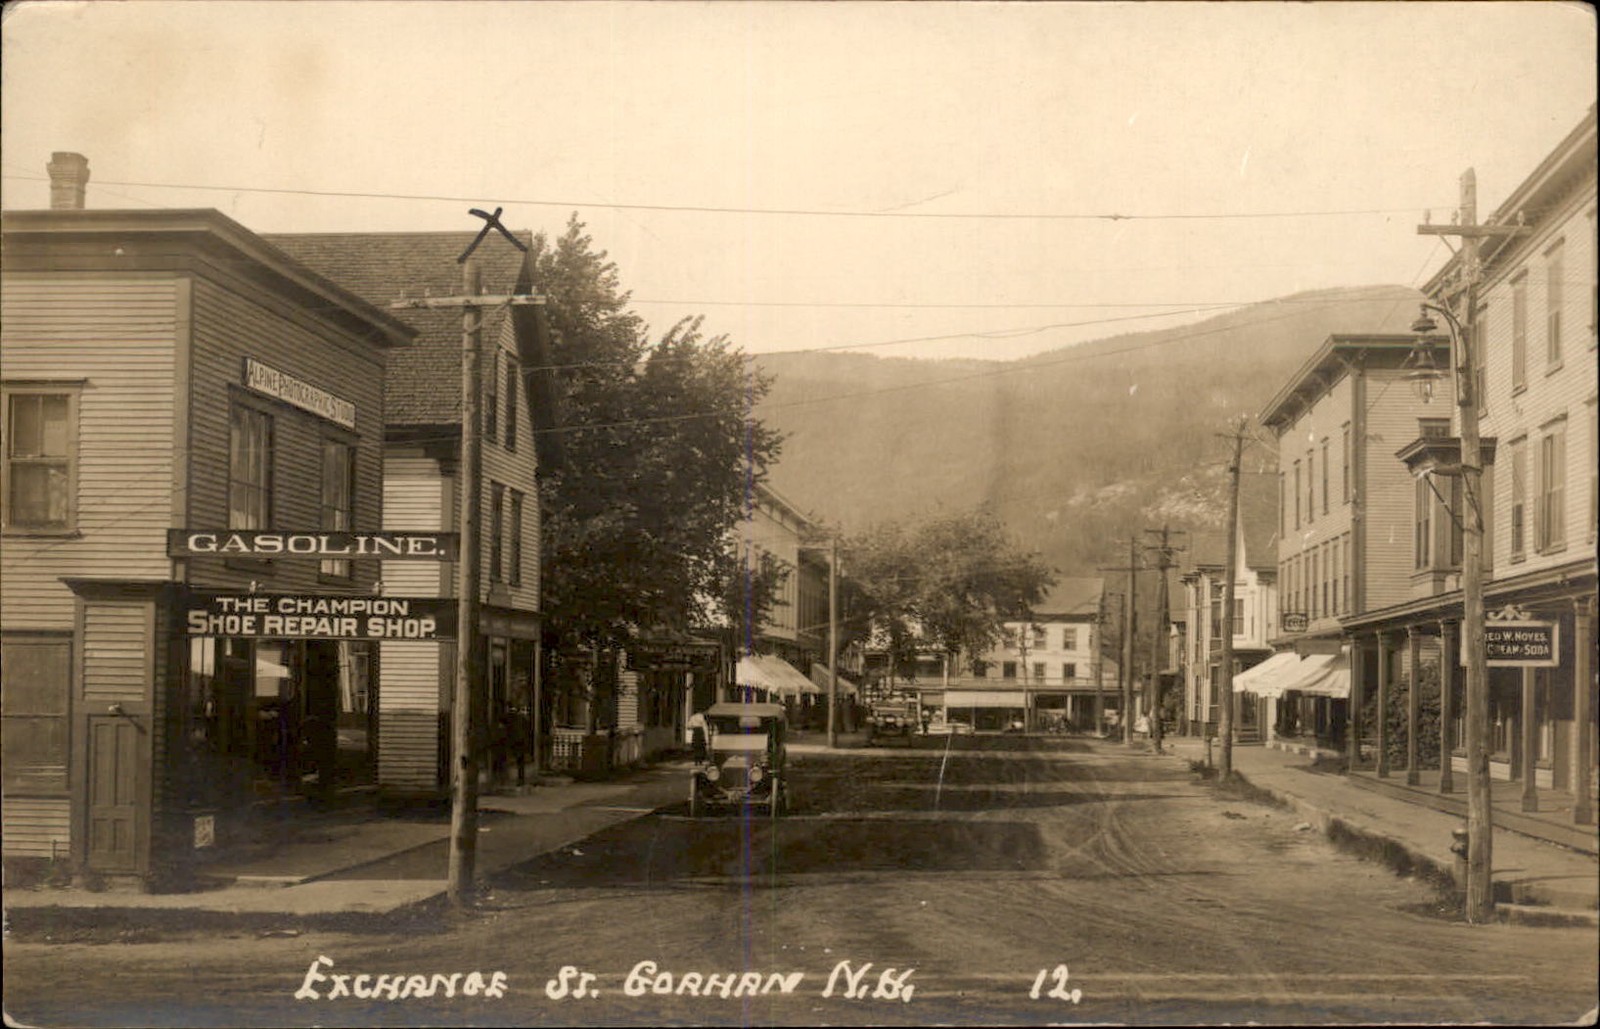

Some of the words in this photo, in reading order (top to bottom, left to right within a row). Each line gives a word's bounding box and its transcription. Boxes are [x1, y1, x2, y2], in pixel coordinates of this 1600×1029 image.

[247, 361, 278, 392] ALPINE
[187, 534, 446, 555] GASOLINE.
[215, 597, 270, 613] THE
[278, 598, 409, 615] CHAMPION
[187, 610, 256, 634] SHOE
[264, 615, 358, 636] REPAIR
[367, 617, 436, 638] SHOP.
